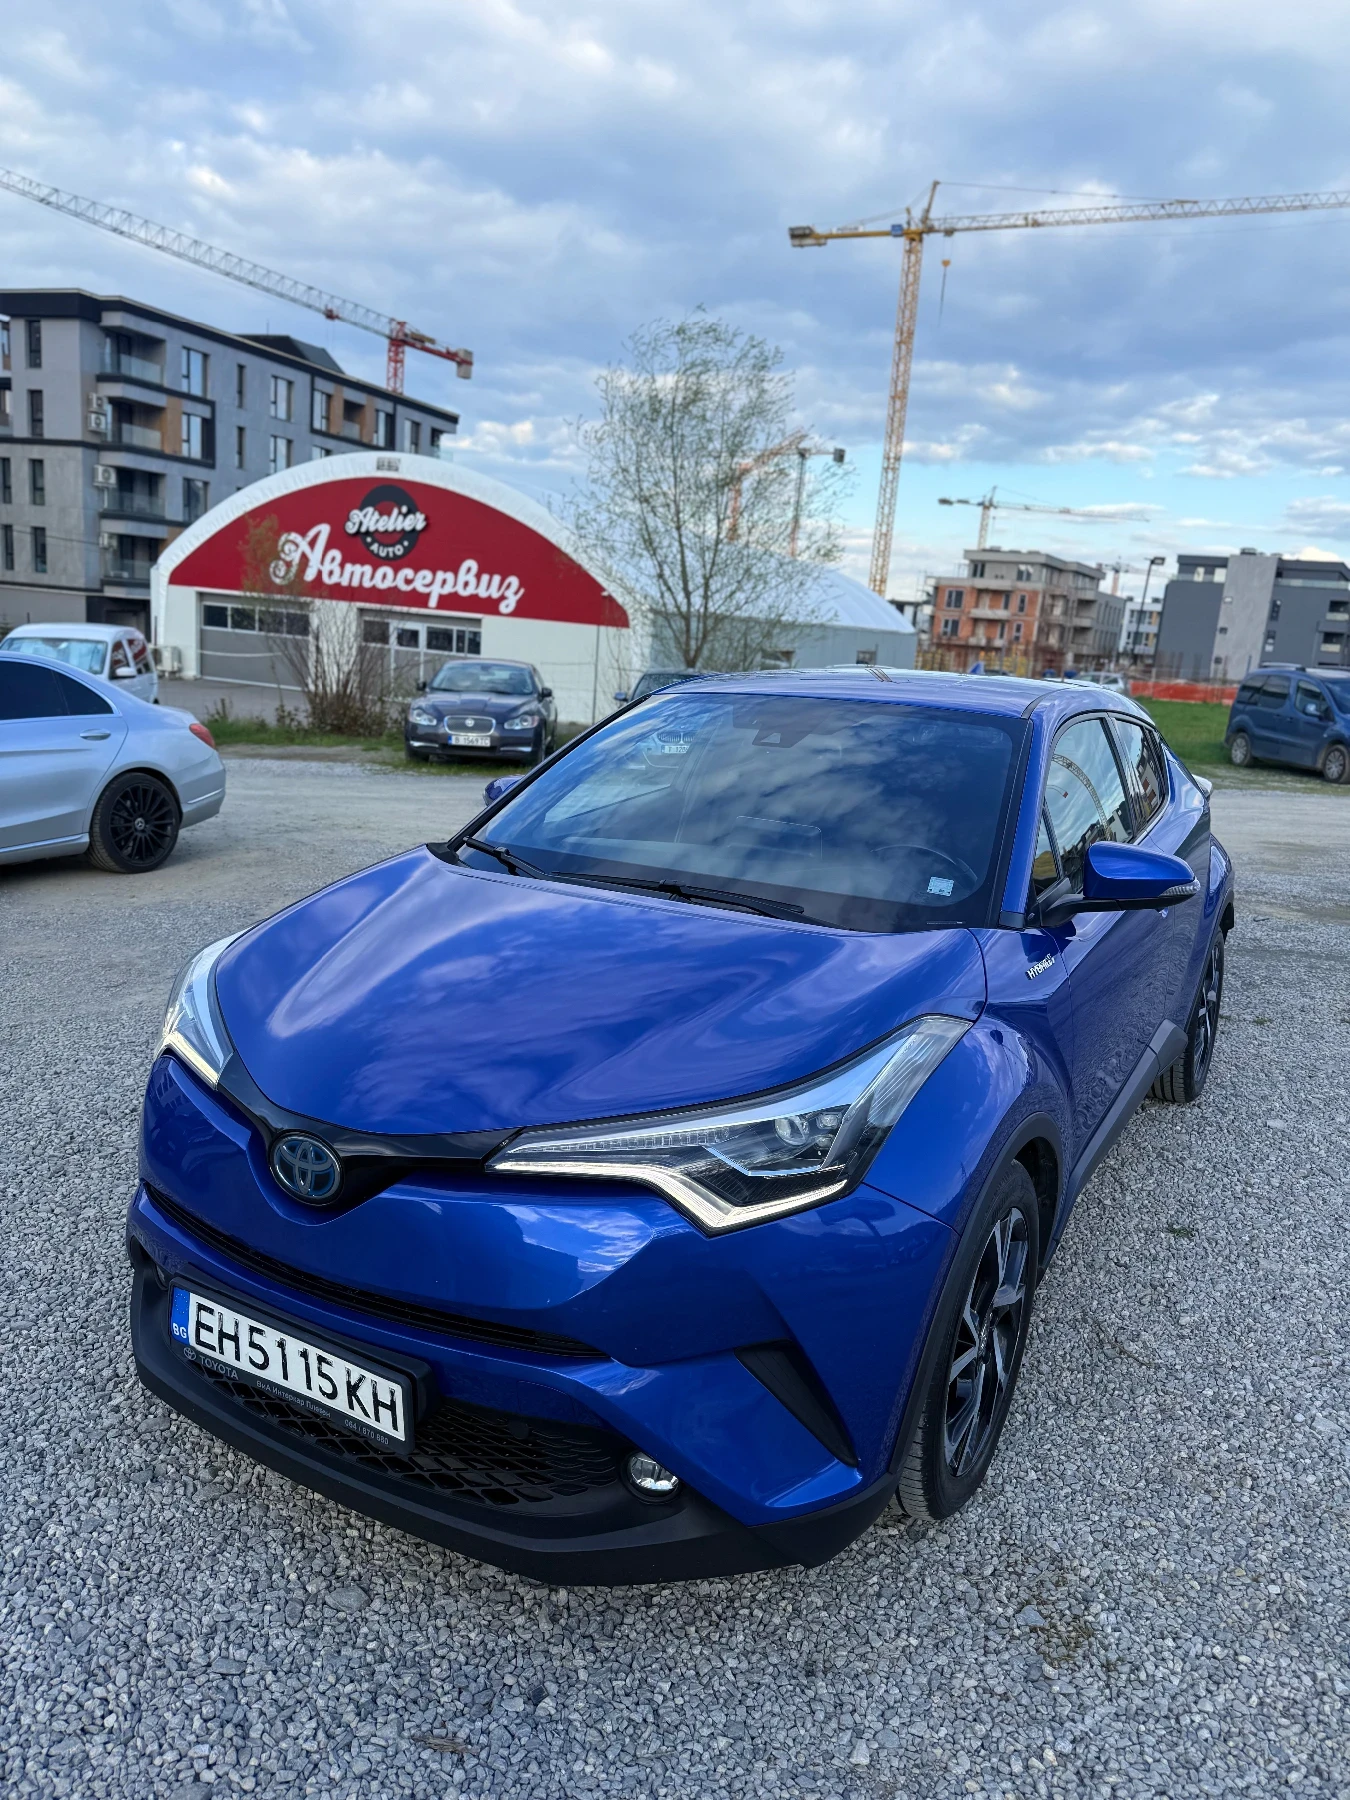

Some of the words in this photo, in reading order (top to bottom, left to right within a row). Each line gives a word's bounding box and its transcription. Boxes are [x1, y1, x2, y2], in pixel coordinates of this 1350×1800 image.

[345, 505, 426, 534] Atelier
[370, 543, 404, 558] AUTO
[269, 523, 525, 614] Автосервиз
[172, 1322, 188, 1340] BG
[200, 1355, 239, 1381] TOYOTA
